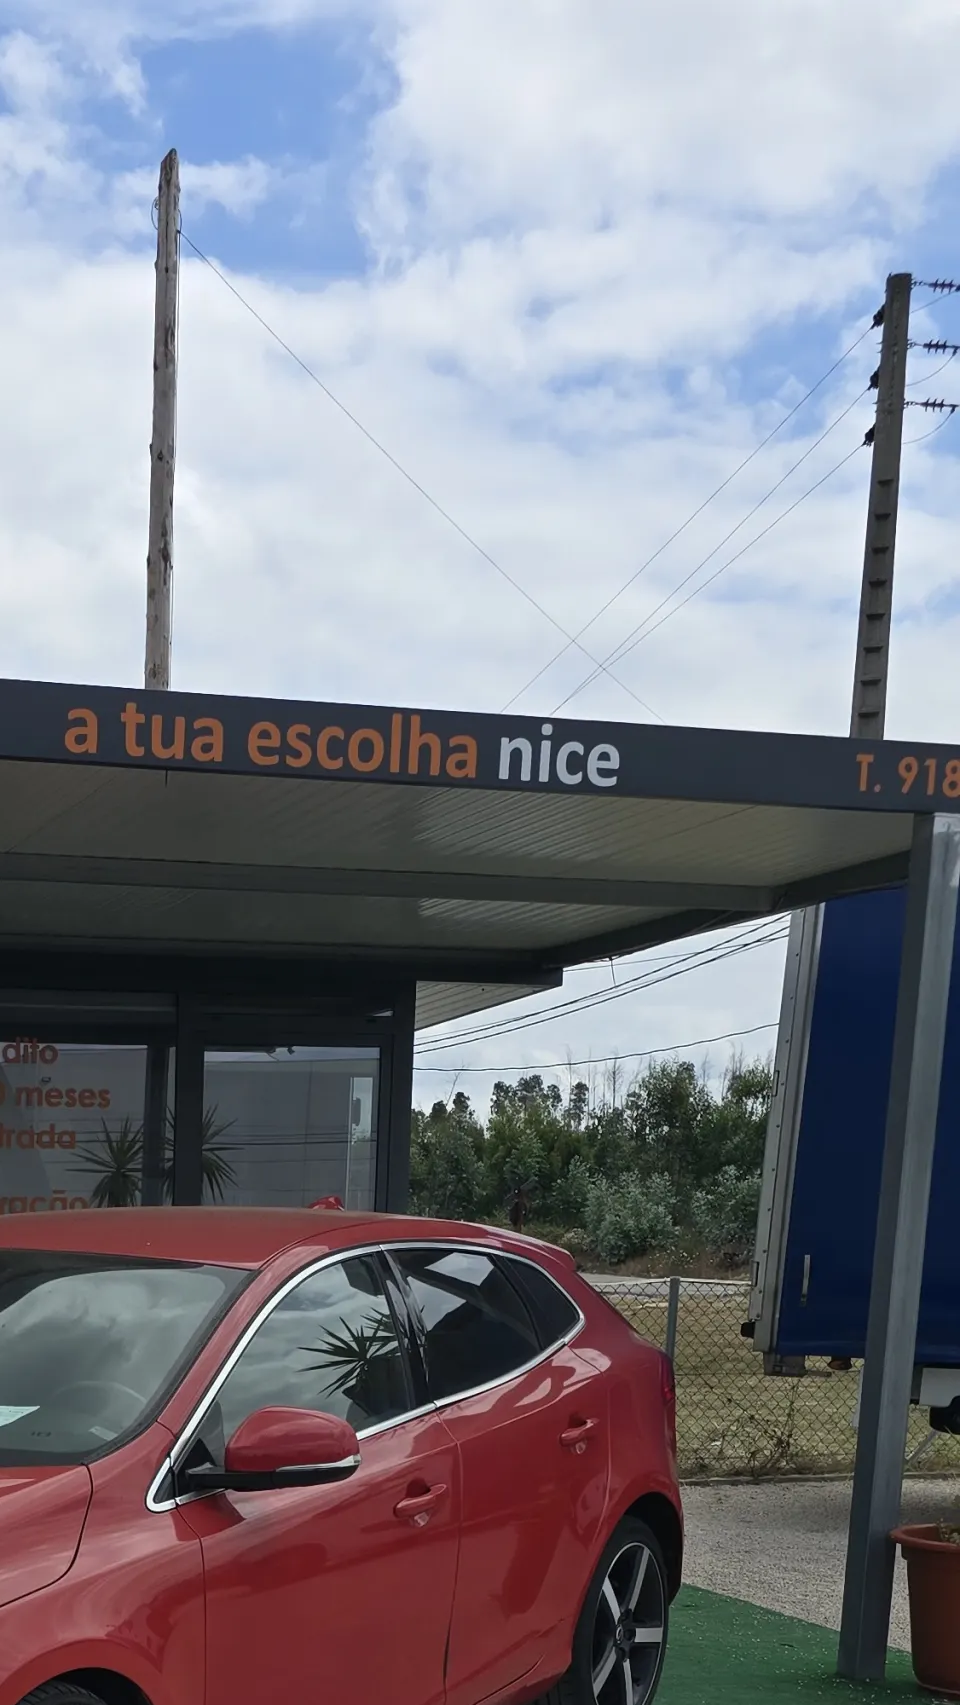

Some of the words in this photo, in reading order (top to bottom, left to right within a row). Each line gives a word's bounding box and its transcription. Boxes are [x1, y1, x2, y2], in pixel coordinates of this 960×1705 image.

[64, 707, 98, 754] a
[120, 701, 224, 762] tua
[247, 712, 478, 779] escolha
[498, 723, 621, 787] nice
[856, 753, 881, 793] T.
[898, 756, 960, 798] 918
[15, 1084, 111, 1109] meses
